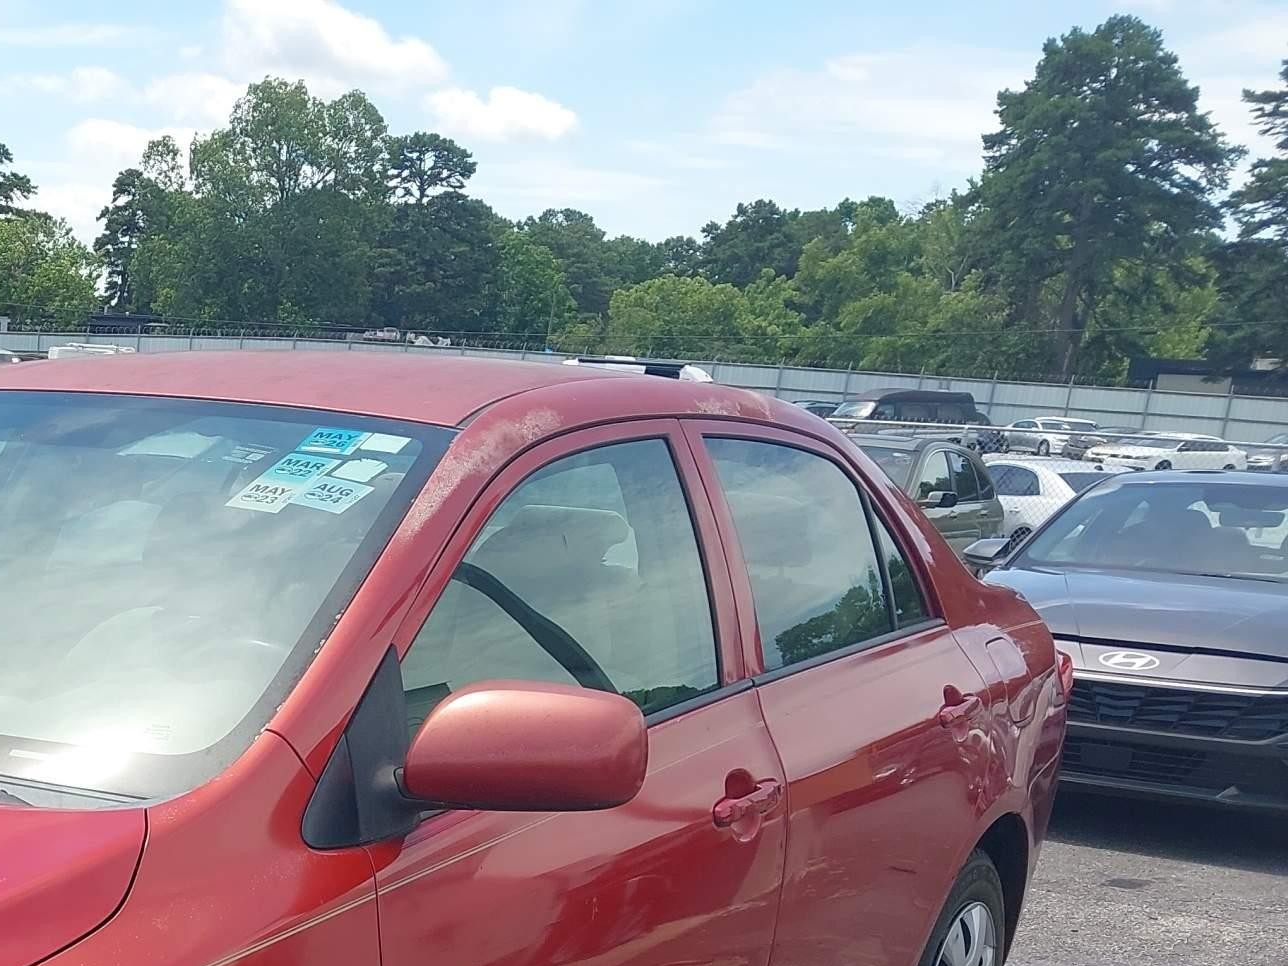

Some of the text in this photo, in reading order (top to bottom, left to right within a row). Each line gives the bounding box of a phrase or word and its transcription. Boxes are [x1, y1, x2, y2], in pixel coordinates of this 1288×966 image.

[313, 431, 361, 441] MAY
[325, 440, 348, 448] 26
[280, 458, 326, 471] MAR
[291, 468, 313, 478] 22
[249, 484, 293, 496] MAY
[313, 483, 354, 497] AUG
[256, 495, 279, 505] 23
[318, 494, 343, 504] 24
